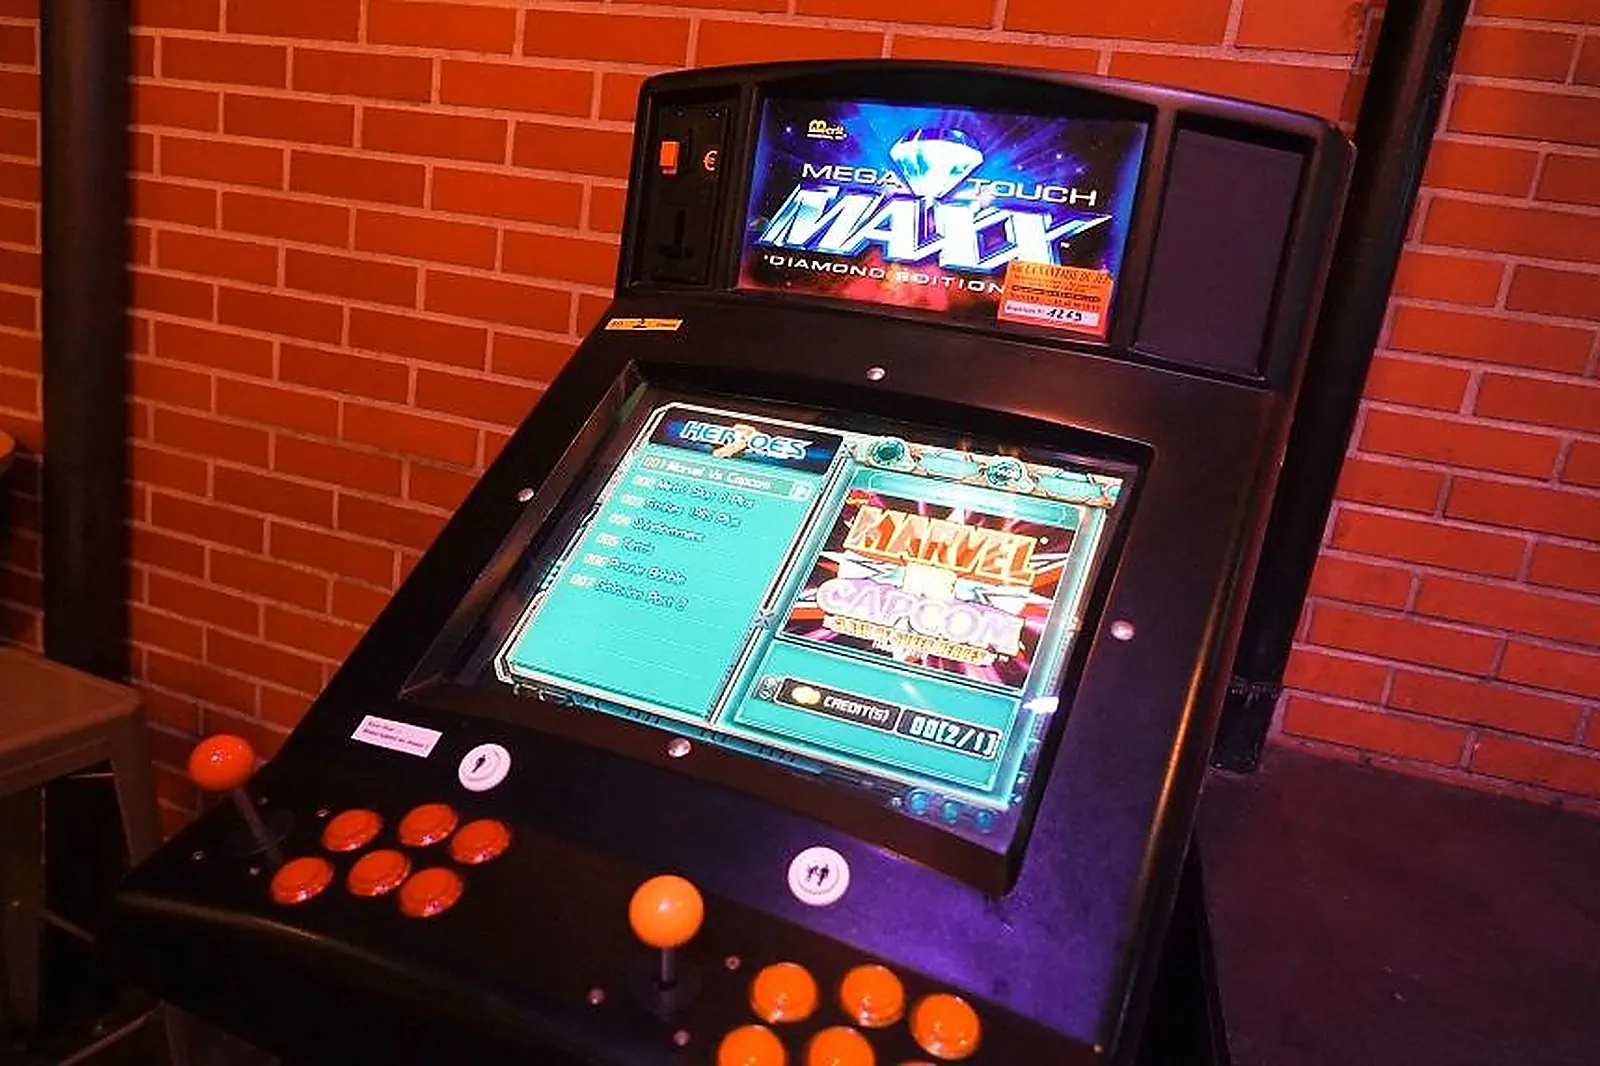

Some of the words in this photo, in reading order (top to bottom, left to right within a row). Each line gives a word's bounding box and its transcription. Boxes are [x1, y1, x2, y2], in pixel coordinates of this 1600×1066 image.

[801, 163, 906, 190] MEGA
[965, 178, 1097, 206] TOUCH
[760, 184, 1112, 273] MAXX
[768, 254, 885, 279] DIAMOND
[895, 270, 1004, 294] EDITION
[681, 420, 812, 459] HEROES
[844, 505, 1039, 585] MARVEL
[817, 578, 1024, 656] CAPCOM
[822, 695, 890, 723] CREDIT(S)
